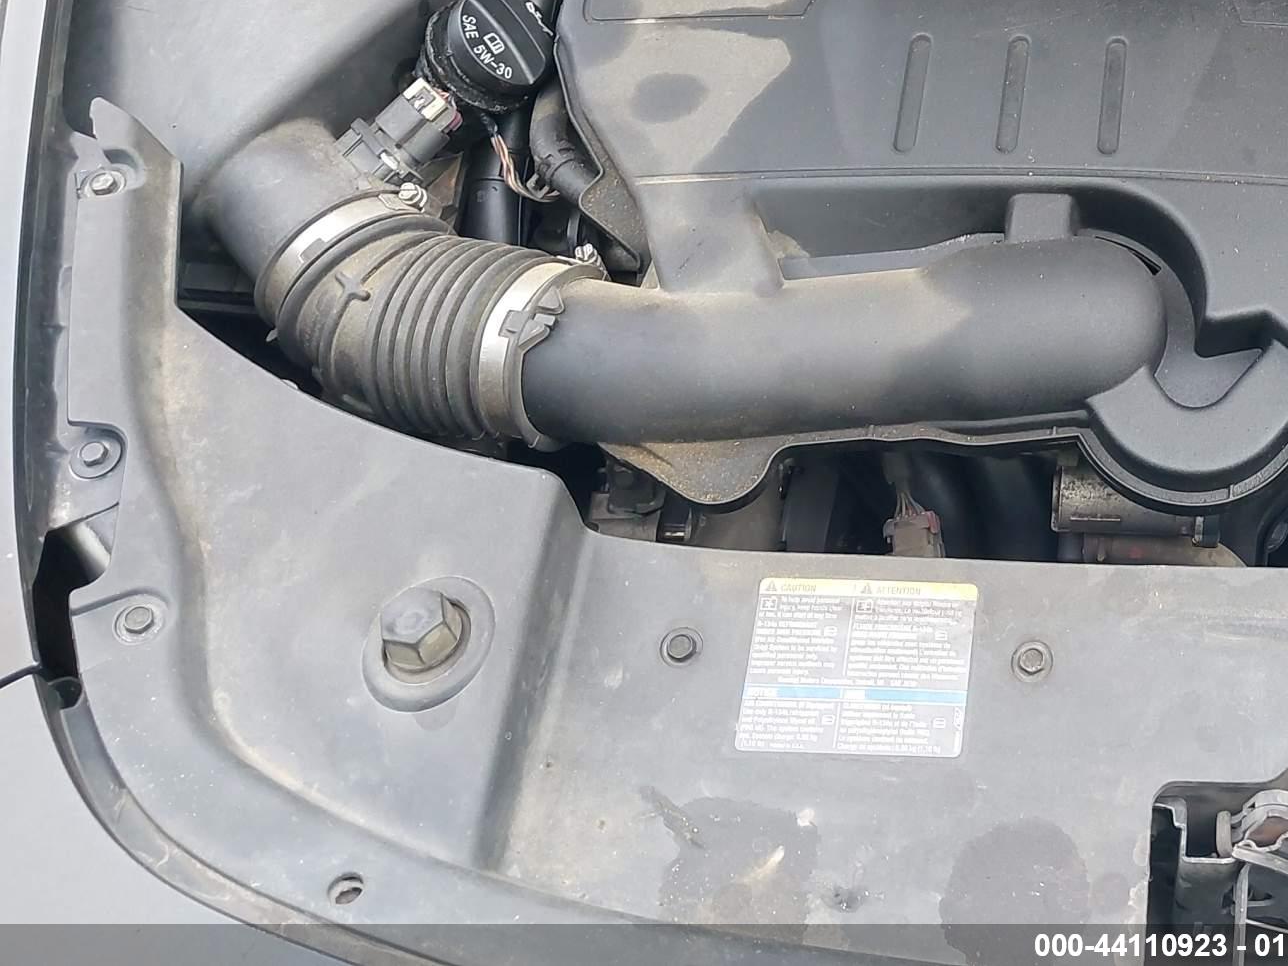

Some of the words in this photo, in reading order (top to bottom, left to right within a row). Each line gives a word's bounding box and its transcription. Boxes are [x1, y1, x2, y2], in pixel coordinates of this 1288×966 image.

[462, 14, 479, 39] SAE
[473, 45, 512, 79] 5W-30
[780, 583, 817, 593] CAUTION
[876, 585, 921, 596] ATTENTION
